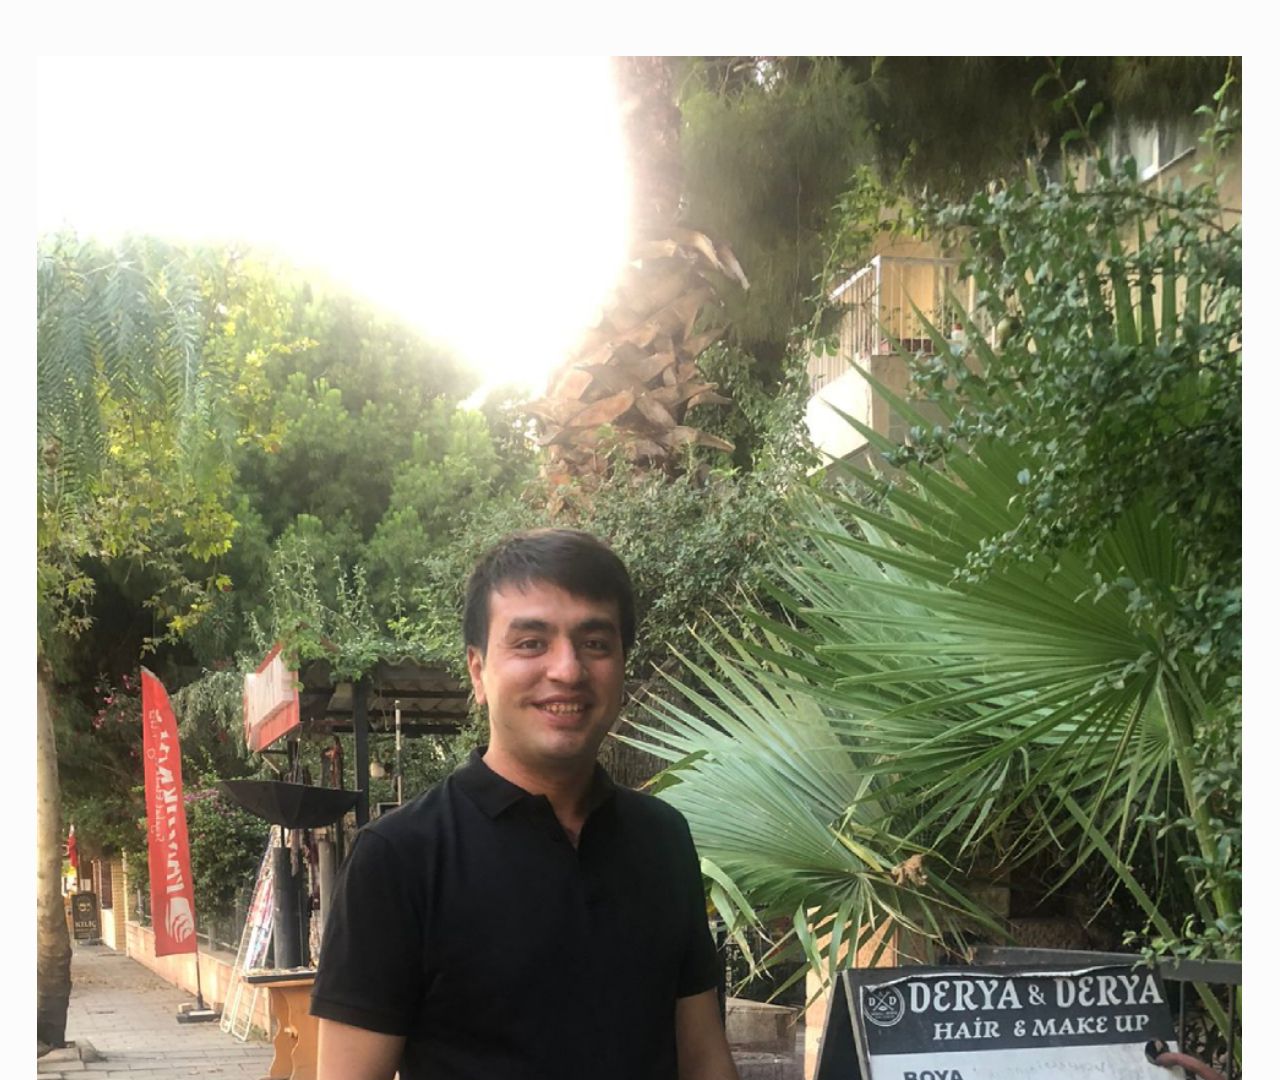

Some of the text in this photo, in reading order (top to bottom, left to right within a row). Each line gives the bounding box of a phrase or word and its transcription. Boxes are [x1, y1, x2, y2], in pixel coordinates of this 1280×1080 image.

[908, 974, 1164, 1013] DERYA & DERYA
[933, 1014, 1150, 1041] HAİR & MAKE UP
